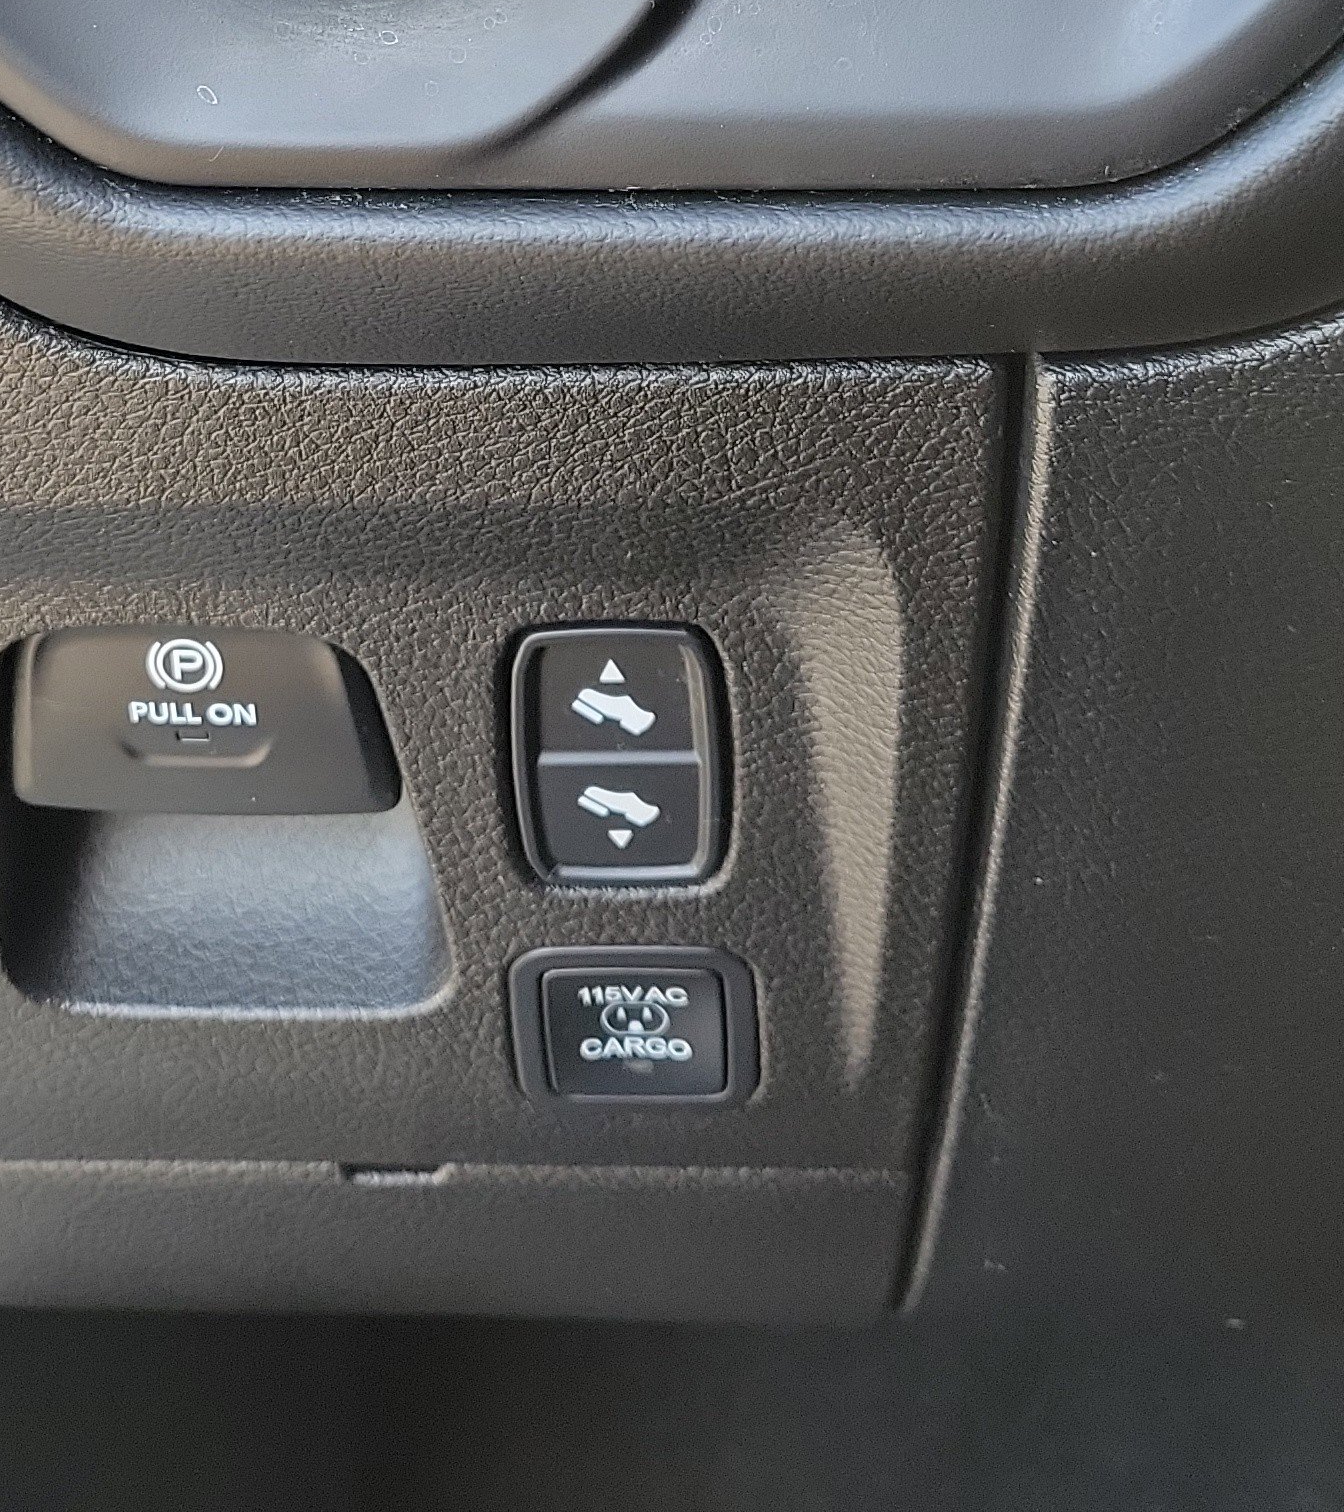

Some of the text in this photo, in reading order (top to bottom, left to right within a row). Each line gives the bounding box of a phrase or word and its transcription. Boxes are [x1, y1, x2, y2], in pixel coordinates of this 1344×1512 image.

[128, 700, 258, 727] PULL ON
[579, 1036, 694, 1062] CARGO
